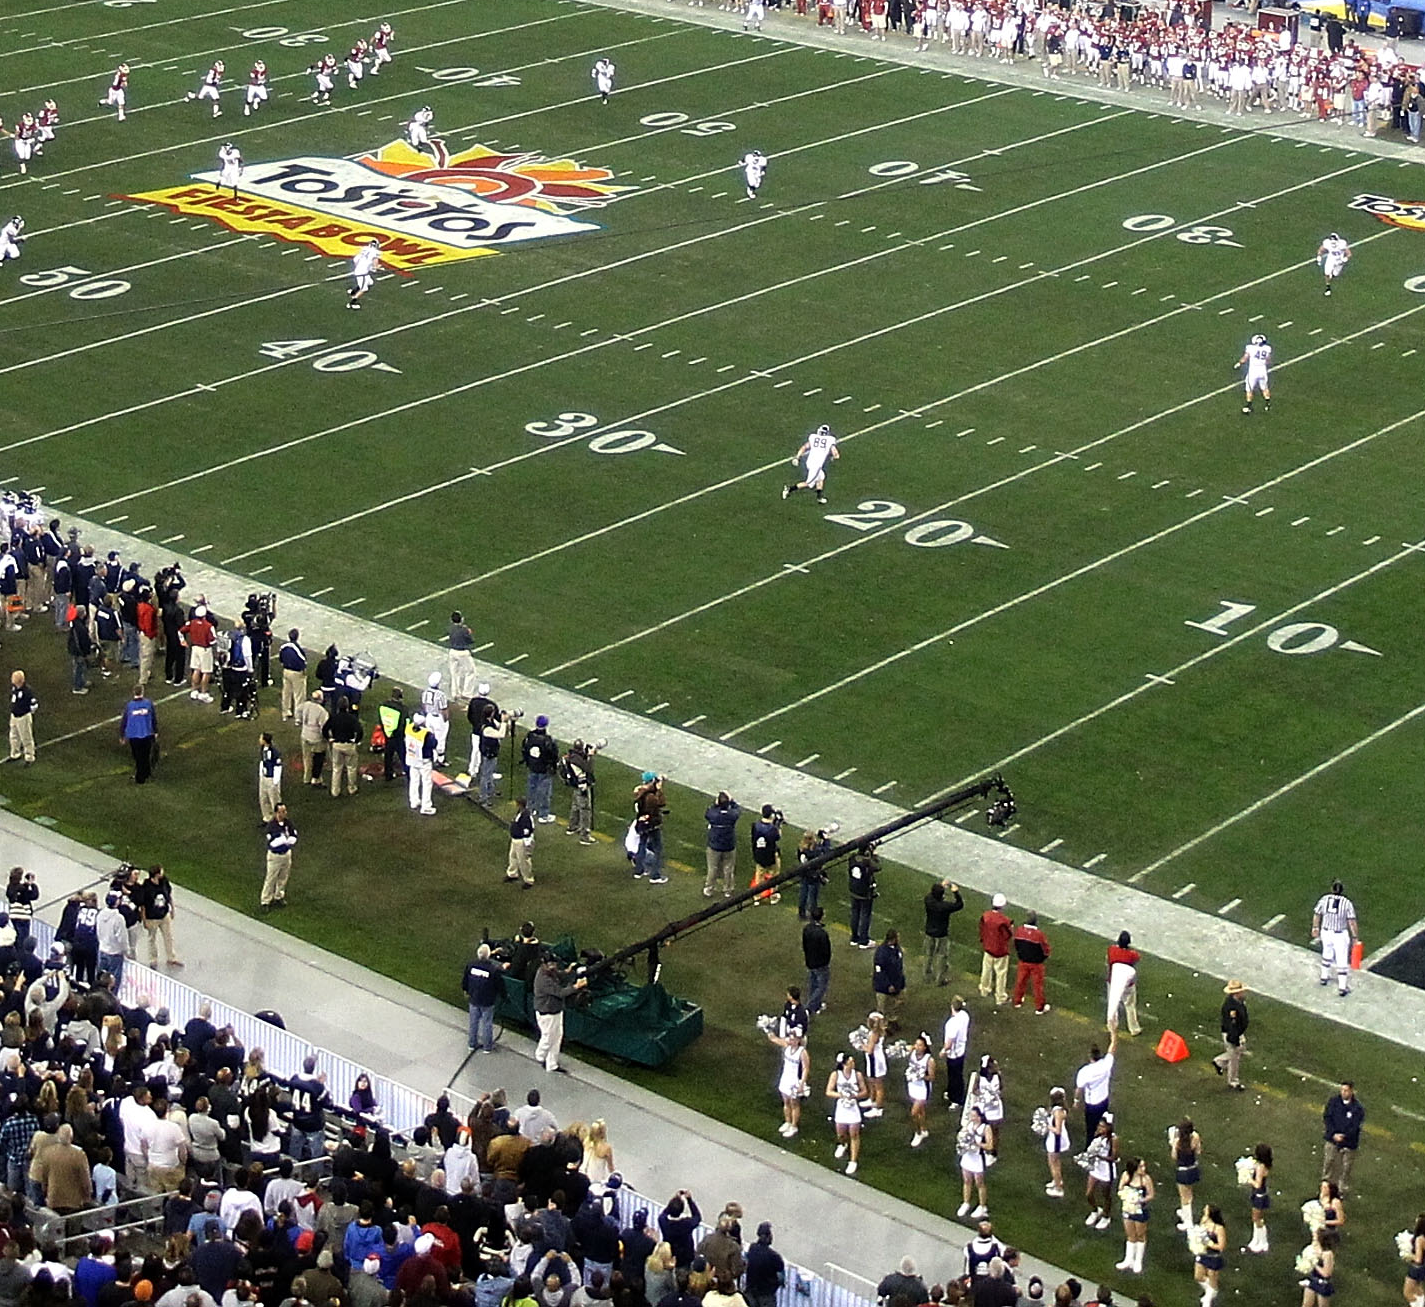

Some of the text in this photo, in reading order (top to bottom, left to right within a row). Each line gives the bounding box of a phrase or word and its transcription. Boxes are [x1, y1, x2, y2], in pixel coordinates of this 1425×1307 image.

[638, 111, 738, 138] 50
[270, 163, 537, 244] Tostitos
[165, 186, 447, 266] FIESTA BOWL
[1122, 214, 1234, 246] 30
[19, 266, 133, 300] 50
[258, 337, 381, 374] 40
[525, 411, 659, 455] 30
[813, 437, 828, 450] 89
[823, 500, 975, 549] 20
[1184, 600, 1342, 656] 10
[1327, 897, 1340, 914] L
[291, 1089, 312, 1112] 44
